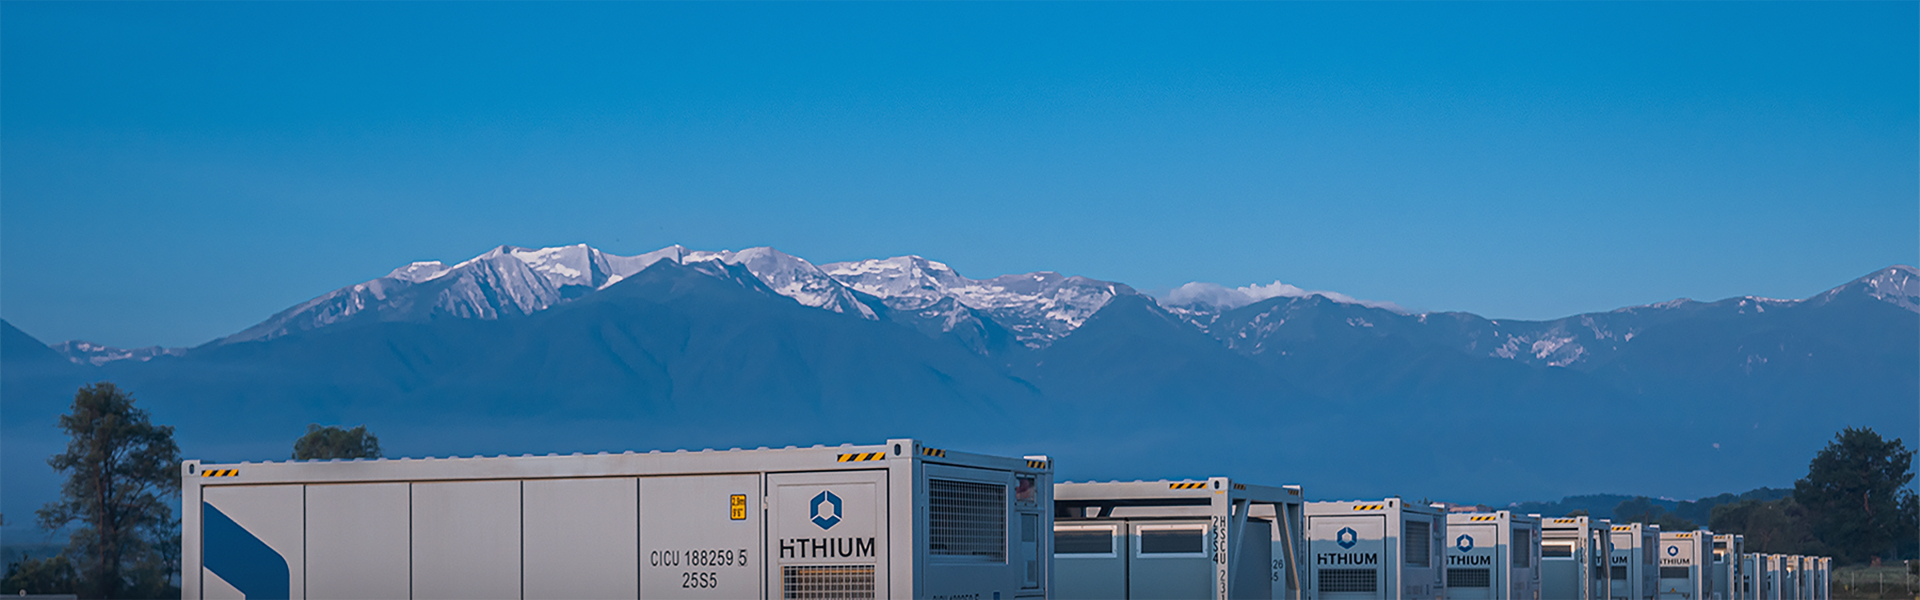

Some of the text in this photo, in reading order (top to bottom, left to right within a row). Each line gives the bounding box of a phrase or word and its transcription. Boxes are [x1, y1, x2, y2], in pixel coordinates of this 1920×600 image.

[650, 549, 748, 567] CICU 188259 5
[682, 572, 718, 589] 25S5
